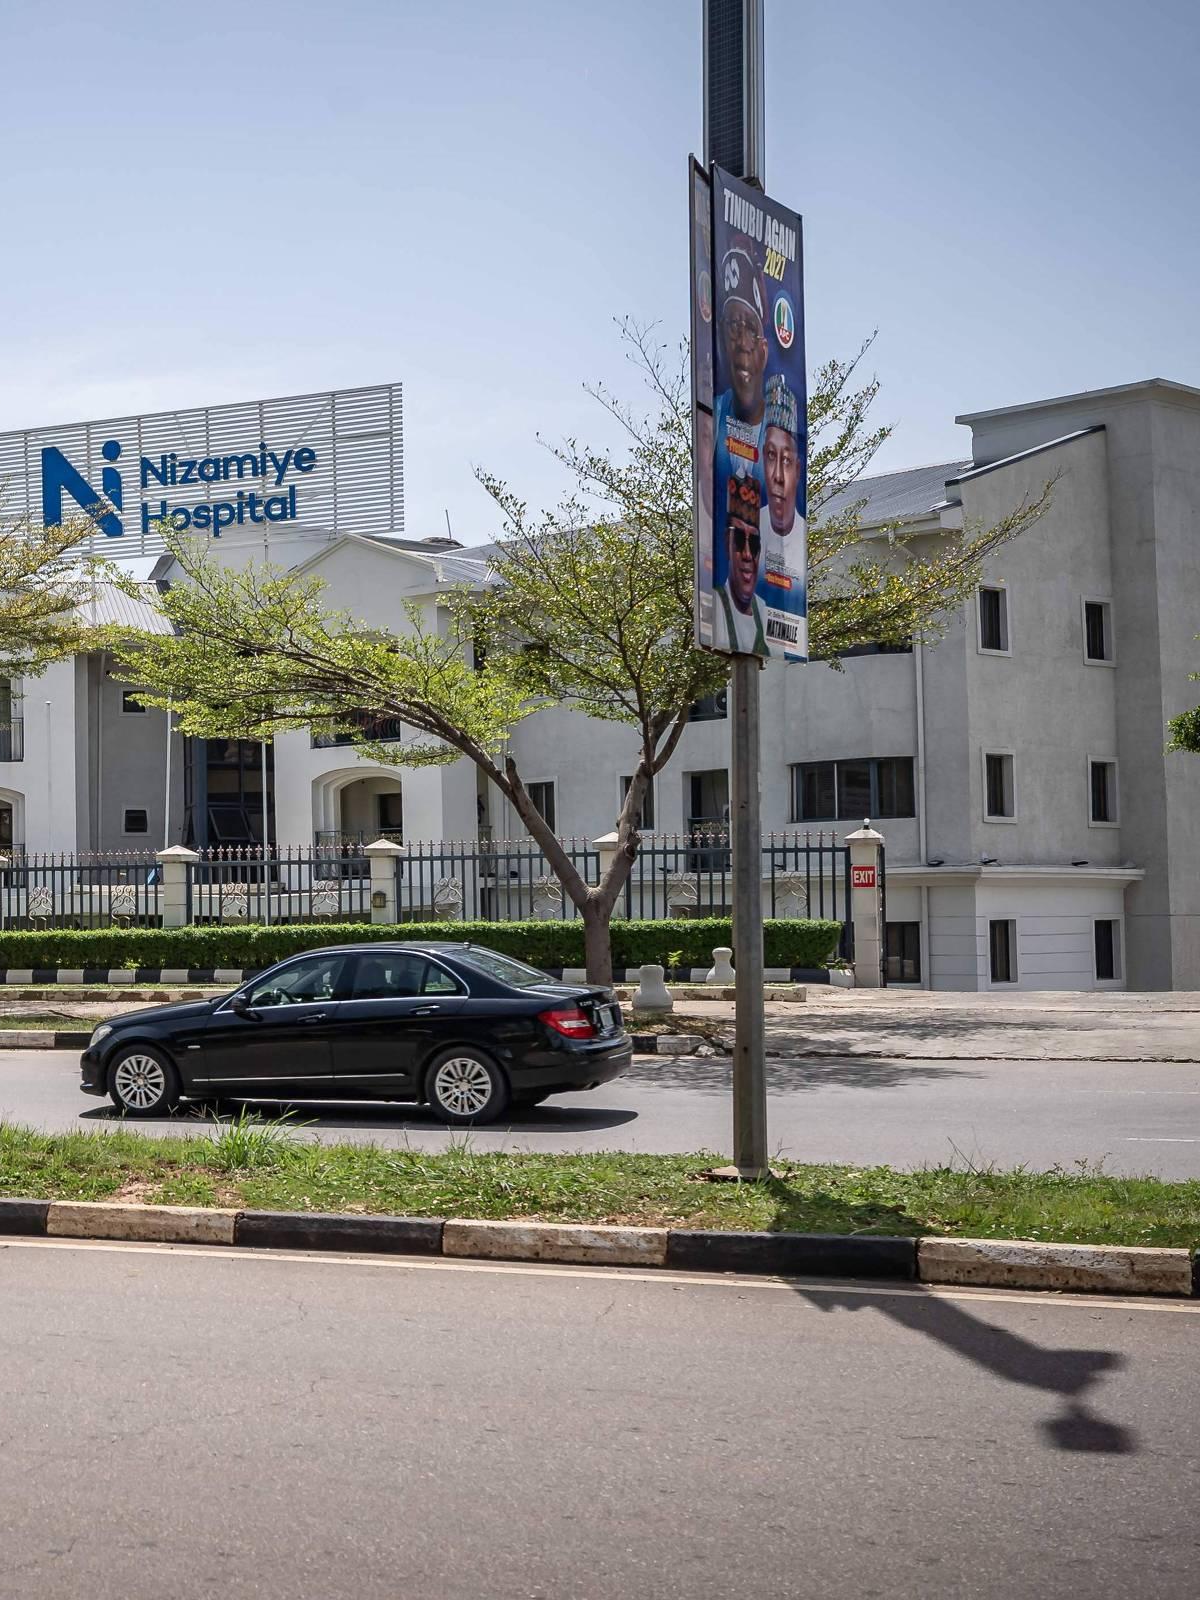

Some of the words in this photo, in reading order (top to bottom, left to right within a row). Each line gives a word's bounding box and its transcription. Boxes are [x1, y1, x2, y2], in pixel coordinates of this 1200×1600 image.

[723, 188, 763, 242] TINUBU
[764, 214, 796, 262] AGAIN
[763, 247, 787, 282] 2027
[141, 441, 317, 489] Nizamiye
[141, 484, 297, 538] Hospital
[854, 870, 874, 884] EXIT
